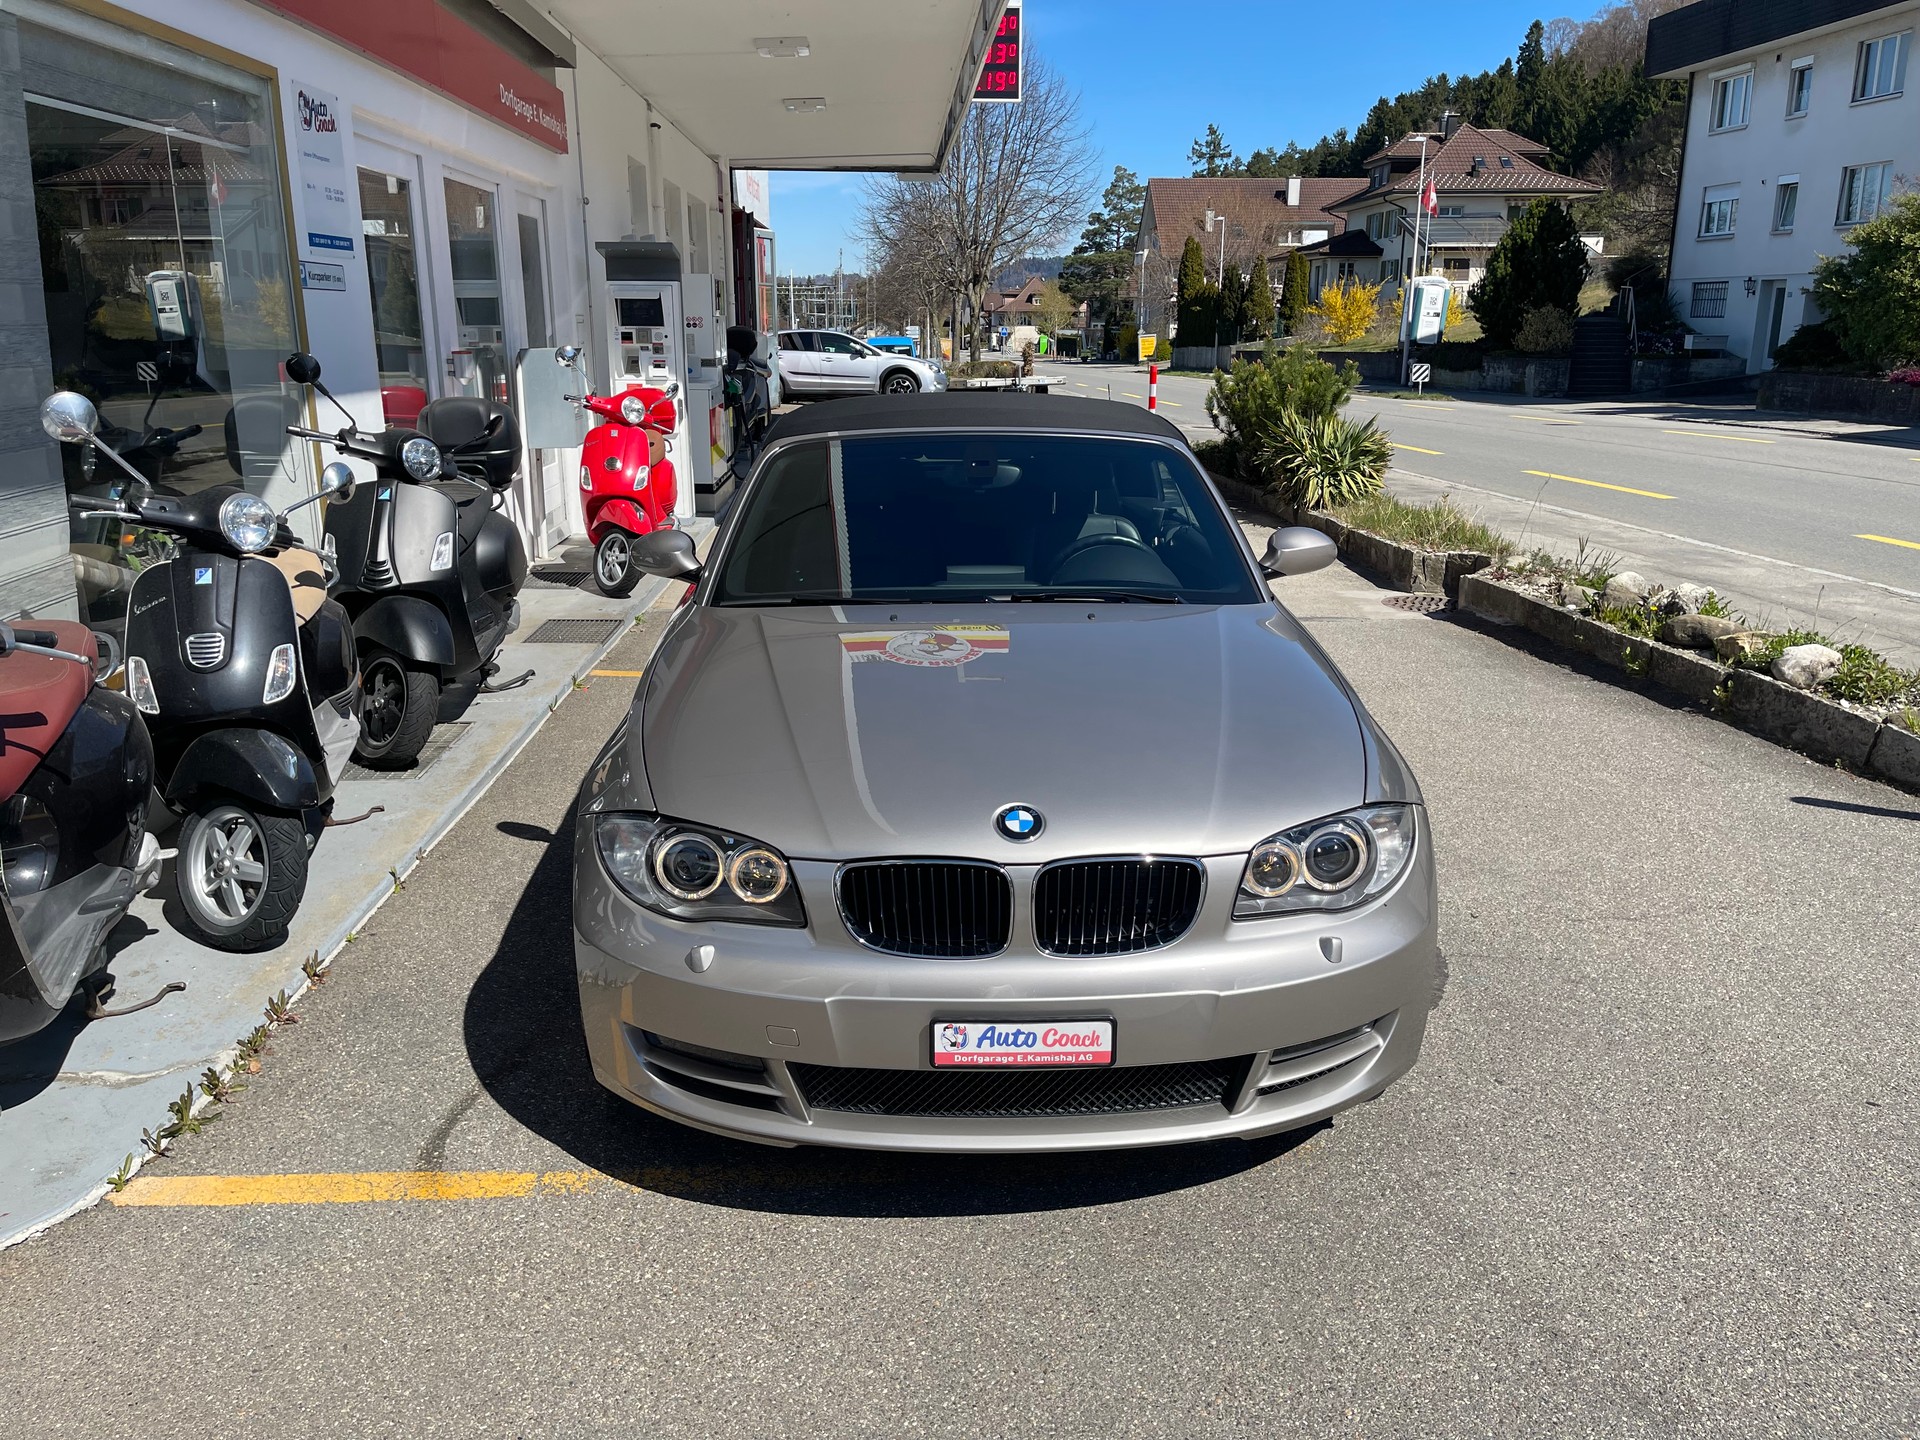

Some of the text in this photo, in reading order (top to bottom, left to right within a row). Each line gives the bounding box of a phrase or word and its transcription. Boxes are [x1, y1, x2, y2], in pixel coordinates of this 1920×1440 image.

[311, 98, 328, 117] Auto
[499, 83, 533, 123] Dorfgarage
[315, 113, 338, 132] Coach
[307, 270, 332, 283] Kurzparker
[1000, 805, 1038, 818] BMW
[976, 1025, 1103, 1048] Auto Coach
[954, 1054, 1014, 1064] Dorfgarage
[1078, 1053, 1093, 1062] AG
